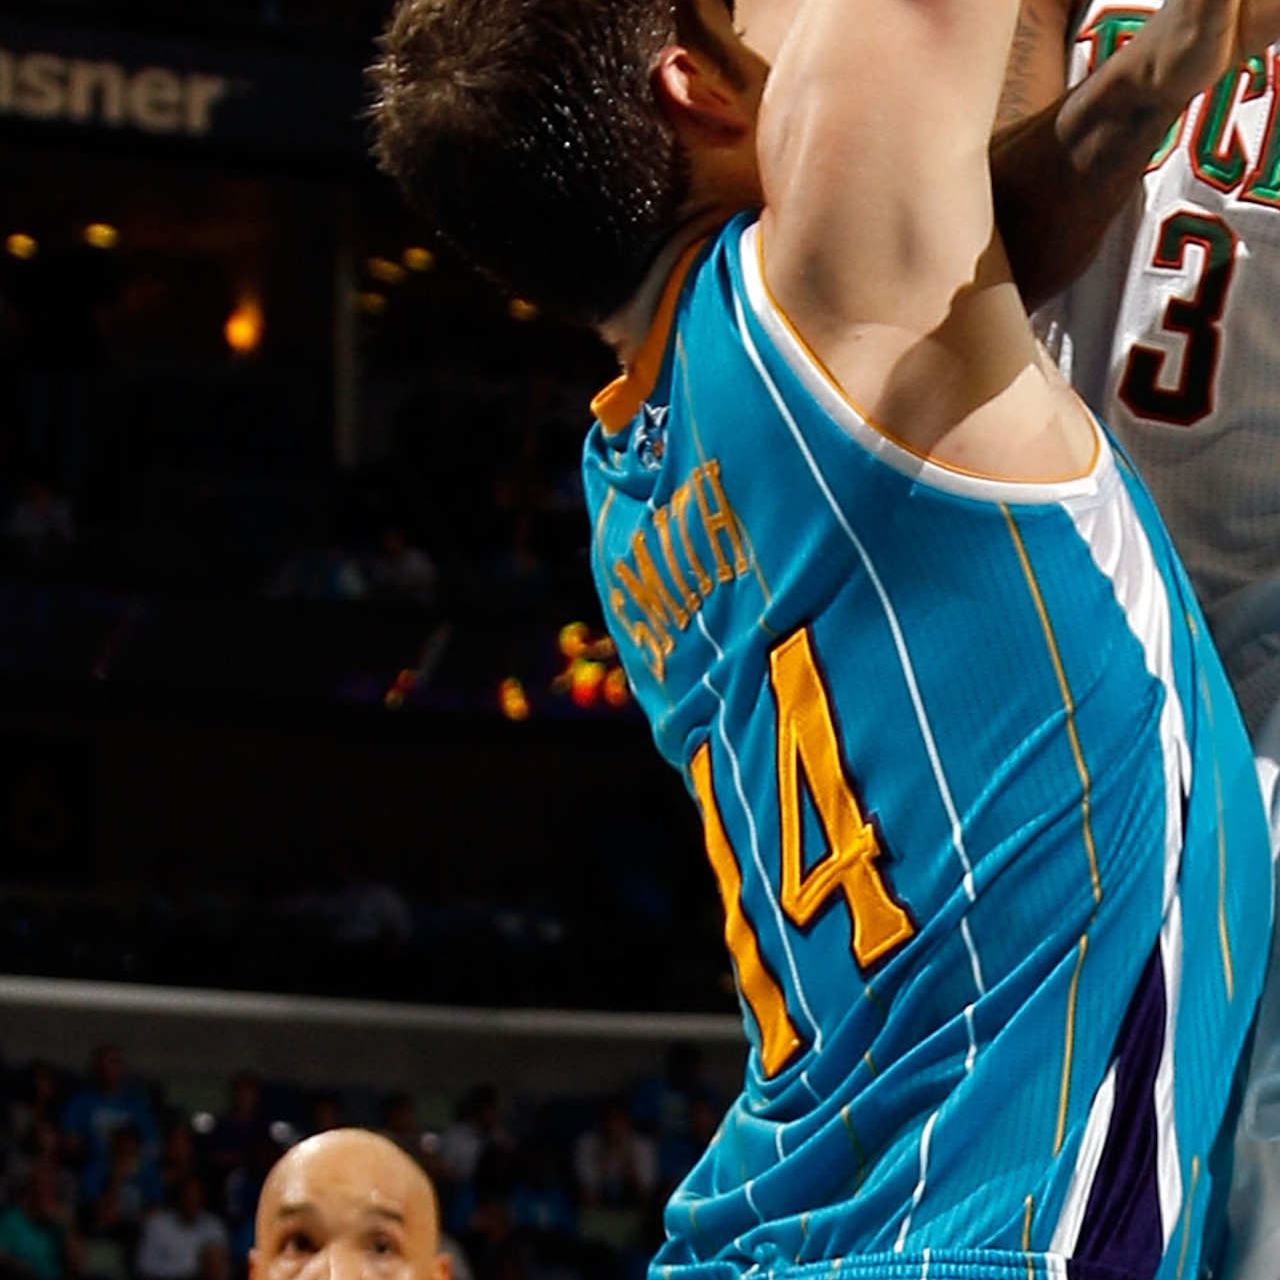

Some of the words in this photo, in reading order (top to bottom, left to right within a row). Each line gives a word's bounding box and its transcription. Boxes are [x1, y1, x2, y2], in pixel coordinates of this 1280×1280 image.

[0, 46, 228, 139] sner
[1118, 210, 1240, 427] 3
[608, 458, 748, 684] SMITH
[688, 623, 917, 1082] 14
